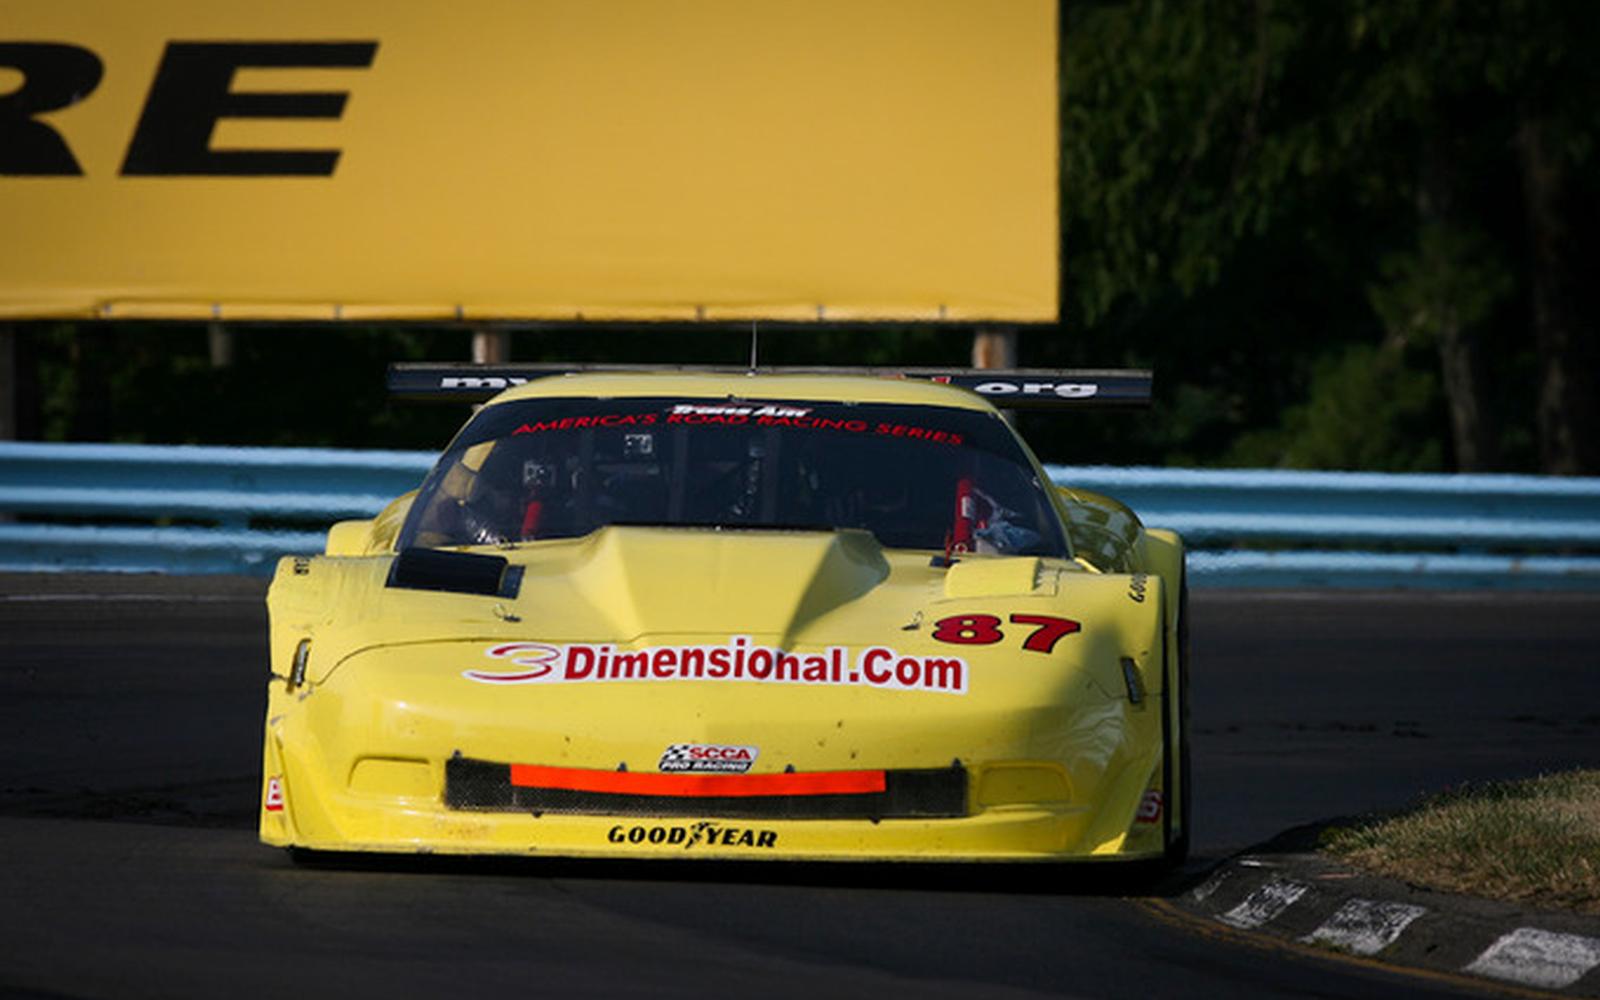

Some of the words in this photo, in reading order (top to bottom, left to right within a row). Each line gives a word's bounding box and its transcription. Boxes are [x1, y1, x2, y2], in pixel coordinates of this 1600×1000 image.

[671, 404, 753, 416] Trans
[511, 413, 658, 436] AMERICA'S
[666, 413, 749, 425] ROAD
[757, 415, 868, 433] RACING
[875, 422, 964, 446] SERIES
[932, 613, 1081, 654] 87
[689, 746, 751, 760] SCCA
[661, 760, 690, 770] PRO
[692, 761, 748, 772] RACING
